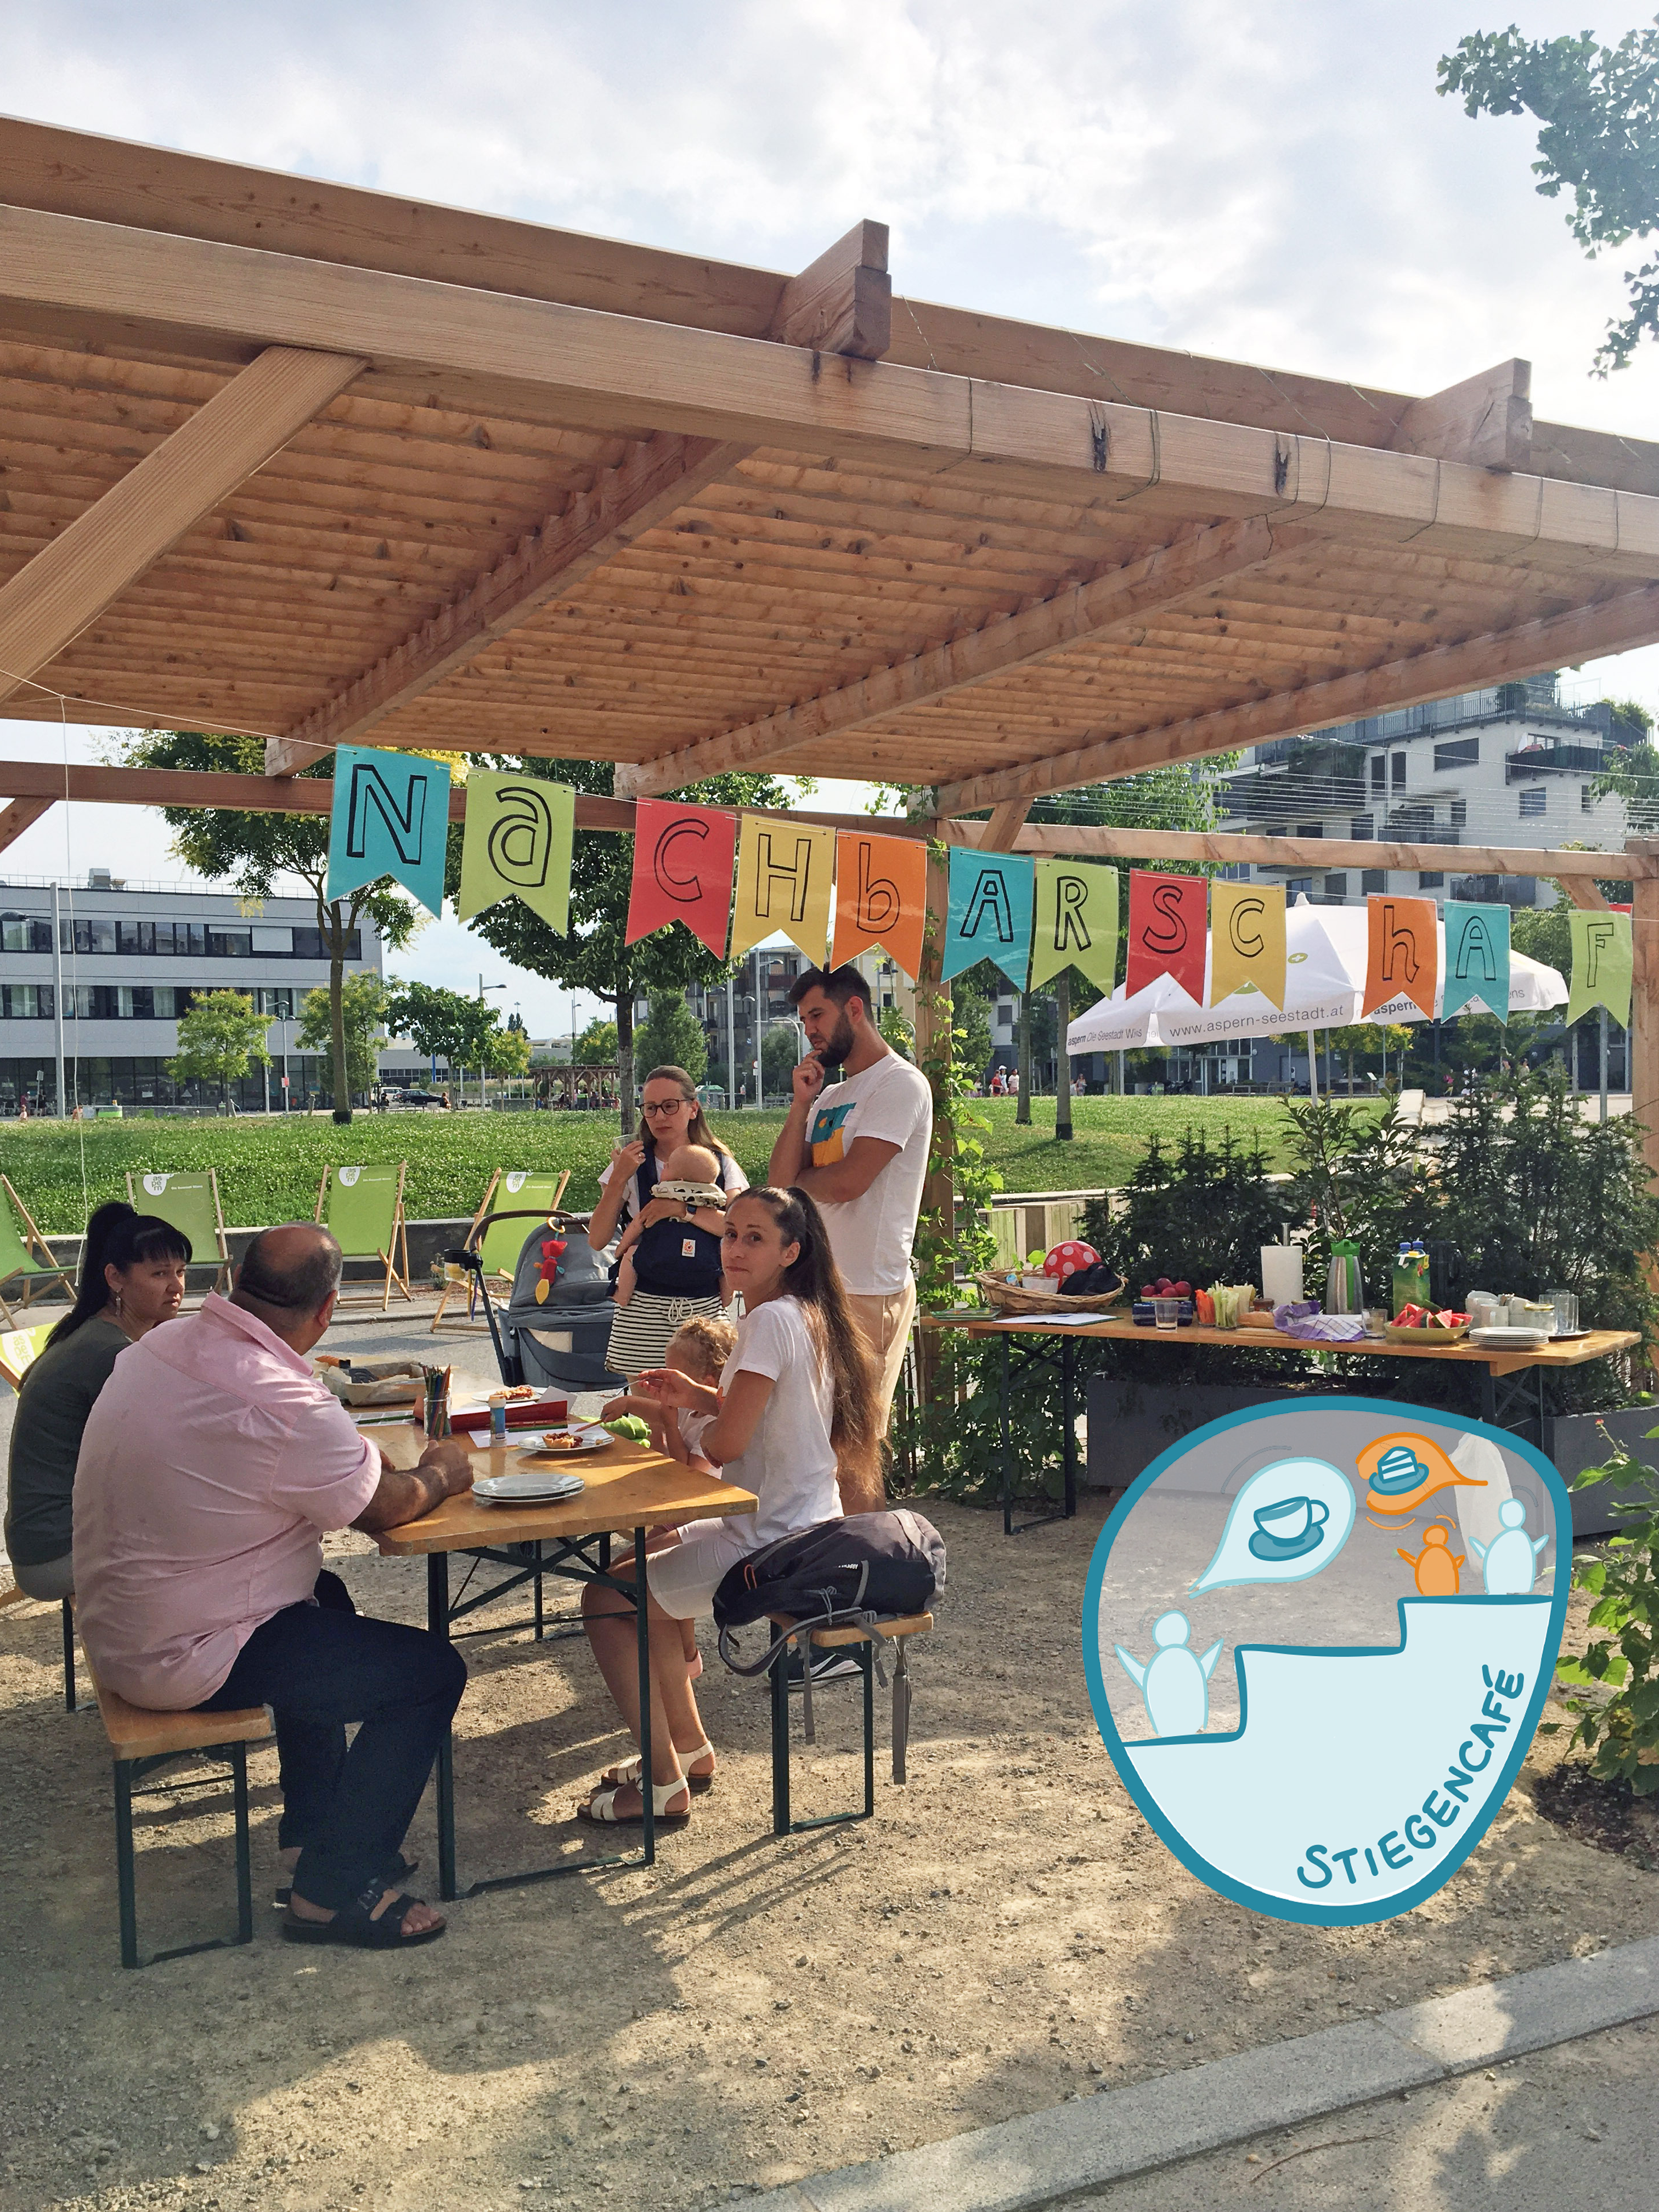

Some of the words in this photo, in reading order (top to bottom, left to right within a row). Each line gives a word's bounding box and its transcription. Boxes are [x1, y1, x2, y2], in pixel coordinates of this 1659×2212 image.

[1170, 1005, 1344, 1037] www.aspern-seestadt.at
[1068, 1035, 1086, 1047] aspern
[1087, 1031, 1097, 1042] Die
[1097, 1029, 1124, 1041] Seestadt
[13, 1335, 25, 1346] as
[14, 1345, 28, 1359] pe
